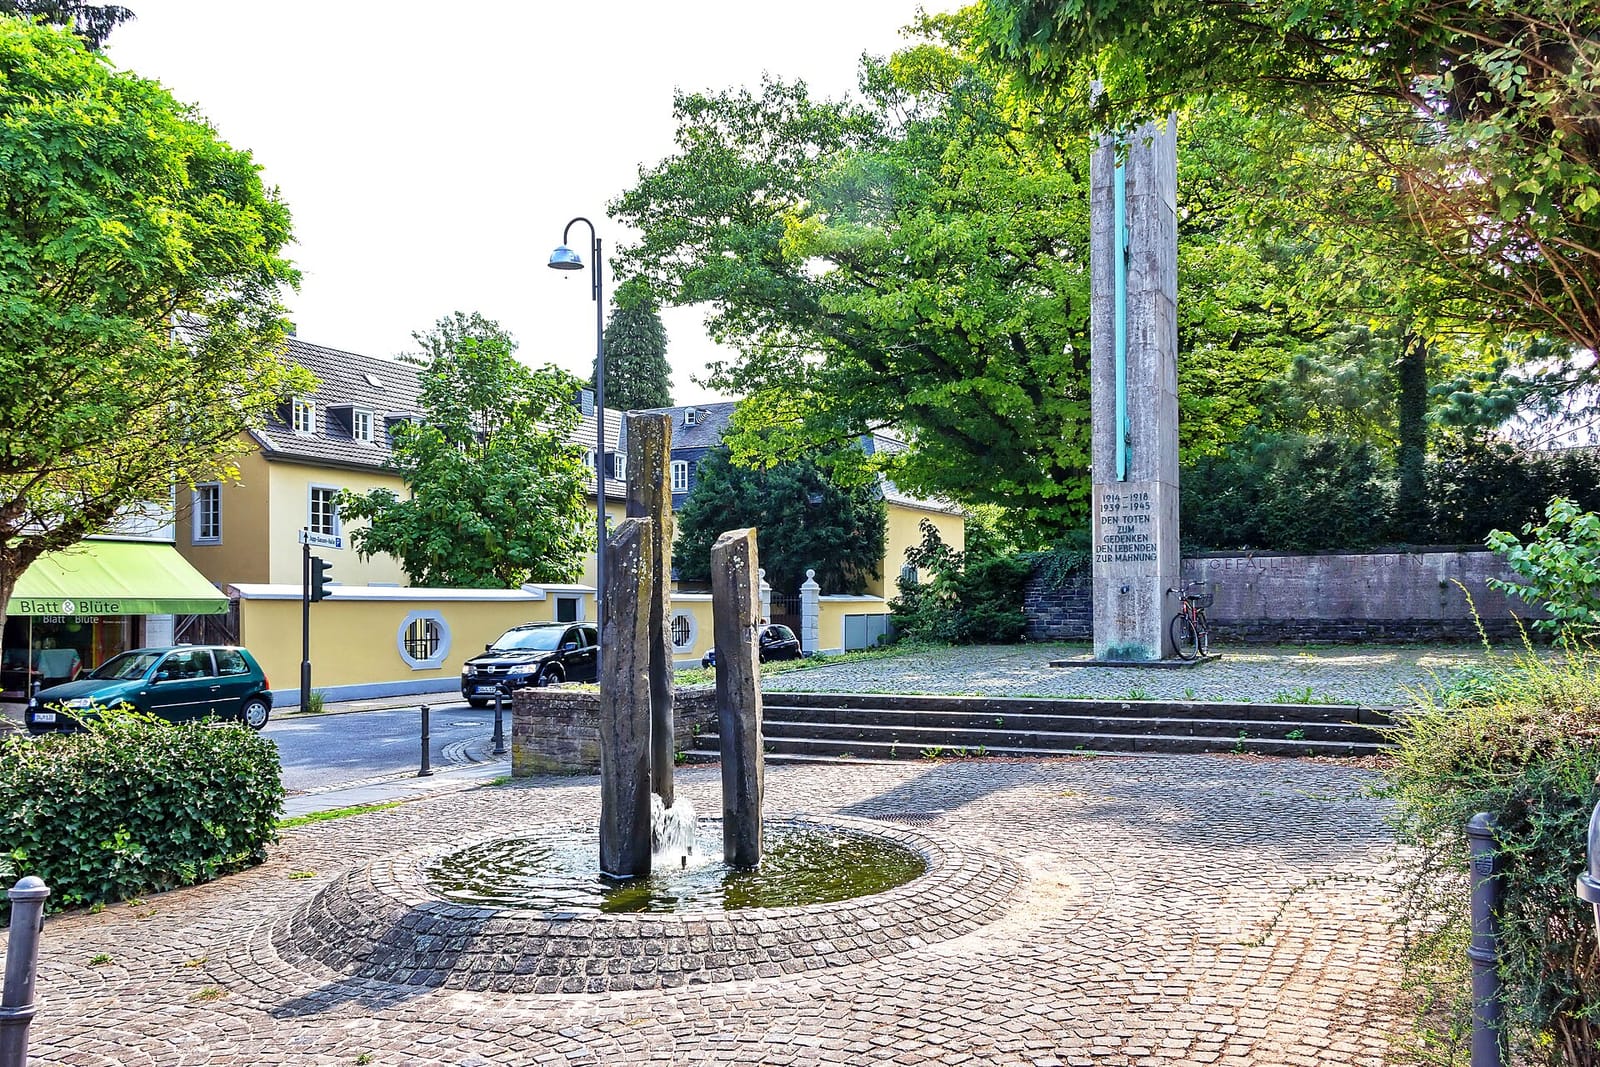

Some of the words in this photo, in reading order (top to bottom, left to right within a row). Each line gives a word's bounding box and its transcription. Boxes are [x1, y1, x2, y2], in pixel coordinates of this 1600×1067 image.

[1102, 494, 1120, 502] 1914
[1130, 493, 1149, 501] 1918
[1100, 503, 1120, 512] 1939
[1130, 502, 1151, 511] 1945
[1101, 515, 1119, 524] DEN
[1122, 515, 1150, 523] TOTEN
[1117, 525, 1135, 534] ZUM
[1103, 534, 1149, 543] GEDENKEN
[1096, 545, 1113, 553] DEN
[1115, 544, 1157, 552] LEBENDEN
[1115, 553, 1157, 562] MAHNUNG
[1209, 556, 1331, 570] GEFALLENEN
[1347, 554, 1424, 567] HELDEN
[20, 600, 59, 613] Blatt
[64, 601, 73, 611] &
[79, 600, 119, 613] Blüte
[43, 615, 66, 624] Blatt
